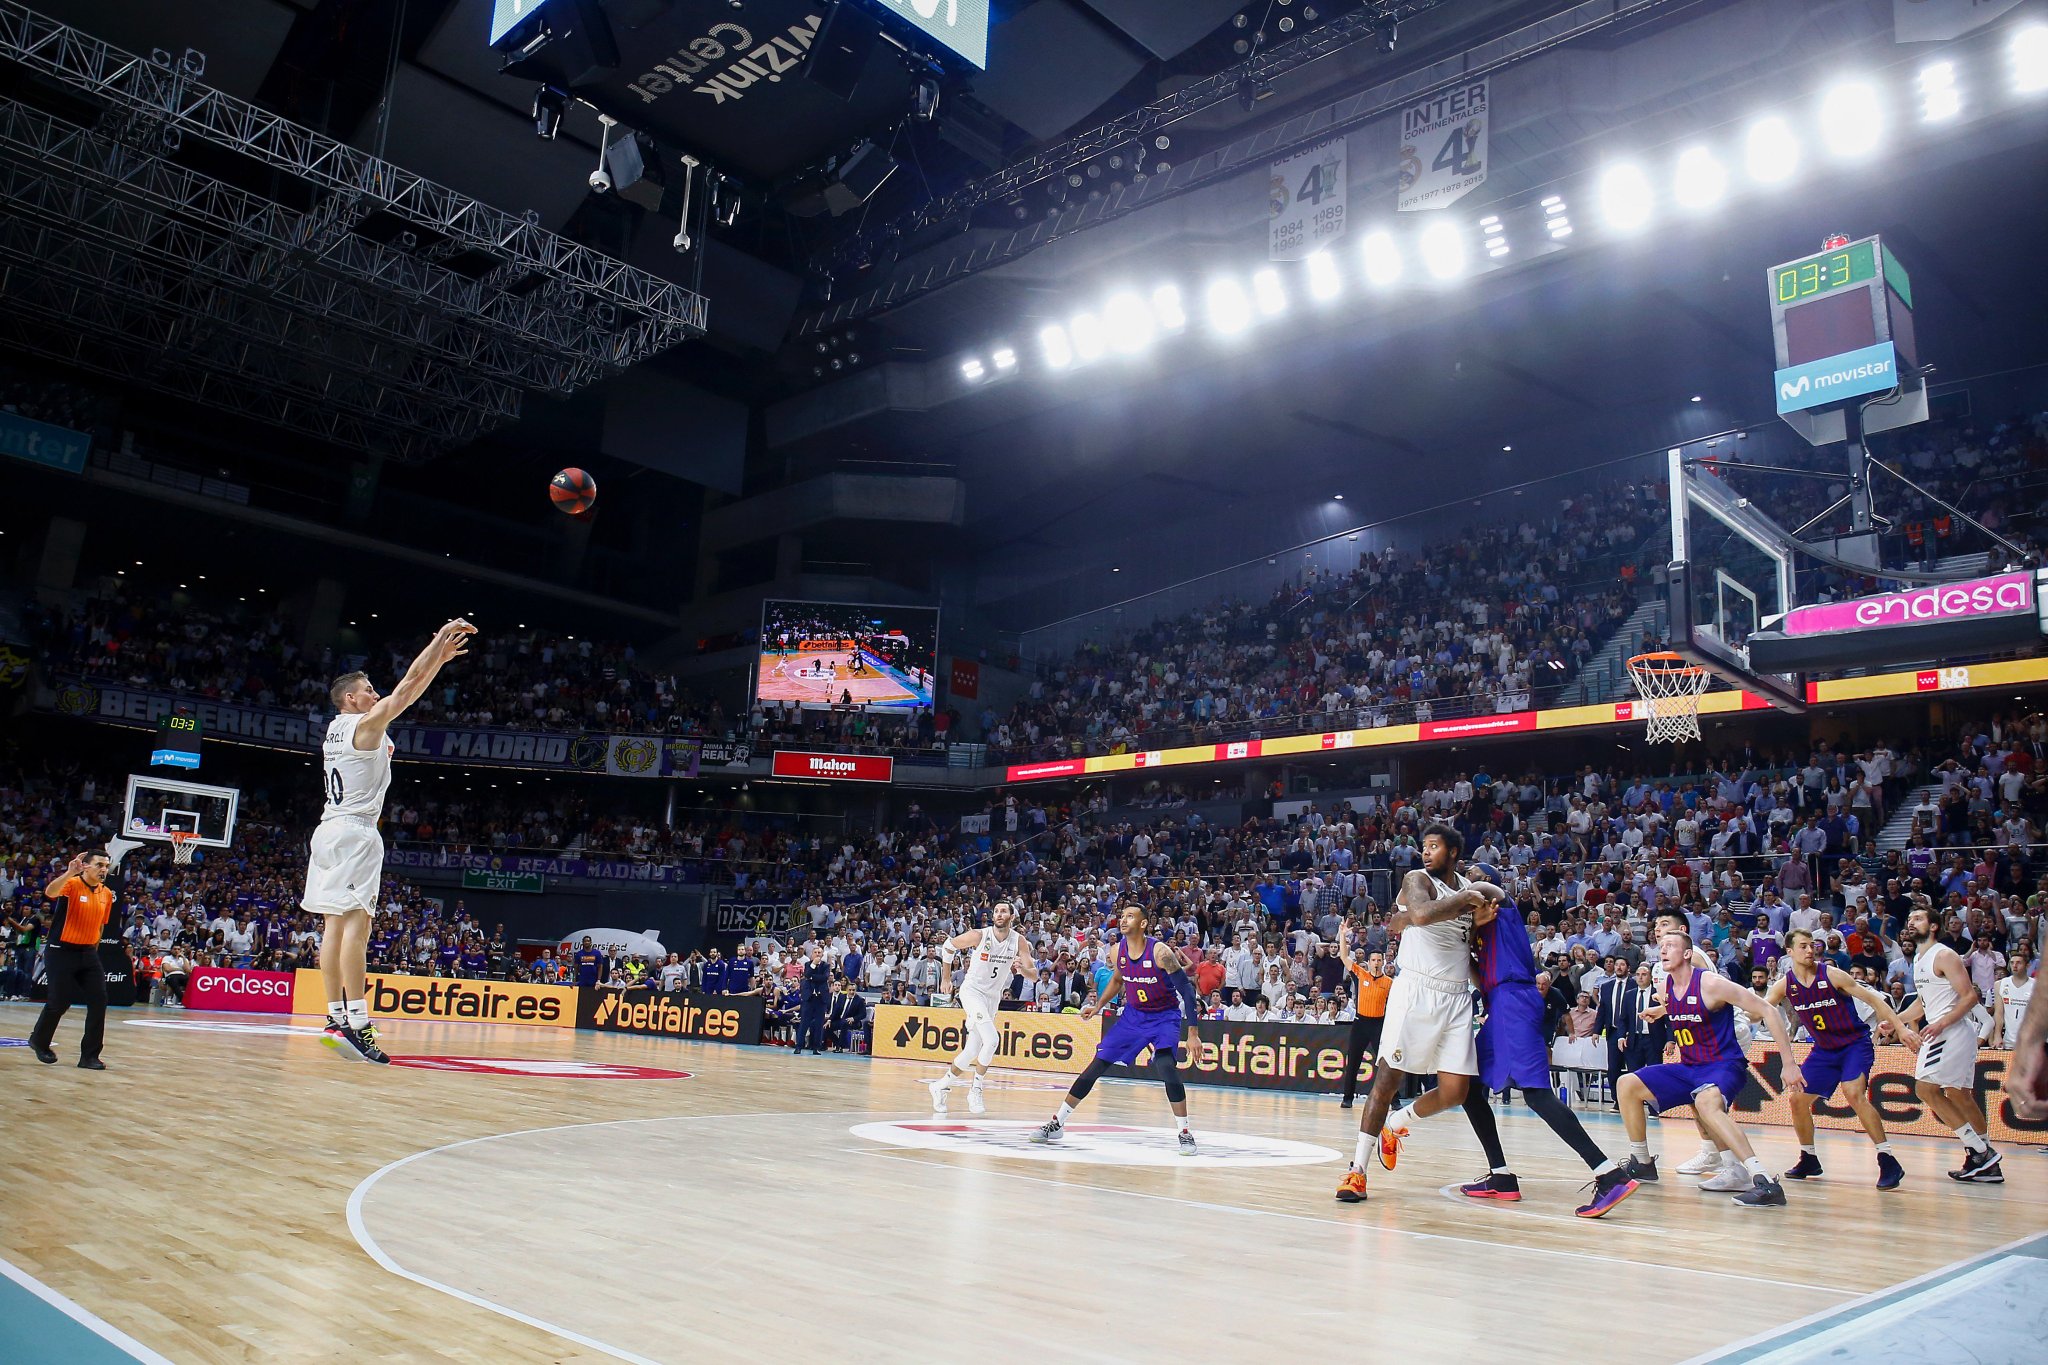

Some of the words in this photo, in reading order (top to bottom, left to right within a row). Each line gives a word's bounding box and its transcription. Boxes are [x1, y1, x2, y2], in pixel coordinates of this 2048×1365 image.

[626, 22, 753, 104] Center
[1403, 103, 1487, 141] CONTINENTALES
[1404, 83, 1486, 132] INTER
[1296, 163, 1326, 206] 4
[1420, 189, 1439, 202] 1977
[1463, 174, 1484, 187] 2015
[1272, 219, 1304, 241] 1984
[1312, 204, 1344, 226] 1989
[1272, 233, 1304, 255] 1992
[1312, 218, 1344, 240] 1997
[1779, 253, 1850, 302] 03:3
[1814, 359, 1891, 389] movistar
[0, 425, 79, 465] nter
[1855, 581, 2026, 625] endesa
[441, 732, 569, 763] MADRID
[701, 750, 732, 761] REAL
[809, 757, 857, 772] Mahou
[518, 858, 574, 875] REAL
[486, 877, 518, 889] EXIT
[1760, 946, 1766, 955] 7
[196, 973, 290, 997] endesa
[990, 966, 999, 979] 5
[373, 978, 561, 1021] betfair.es
[1136, 989, 1148, 1003] 8
[616, 993, 740, 1038] betfair.es
[1812, 1014, 1827, 1031] 3
[1673, 1028, 1694, 1047] 10
